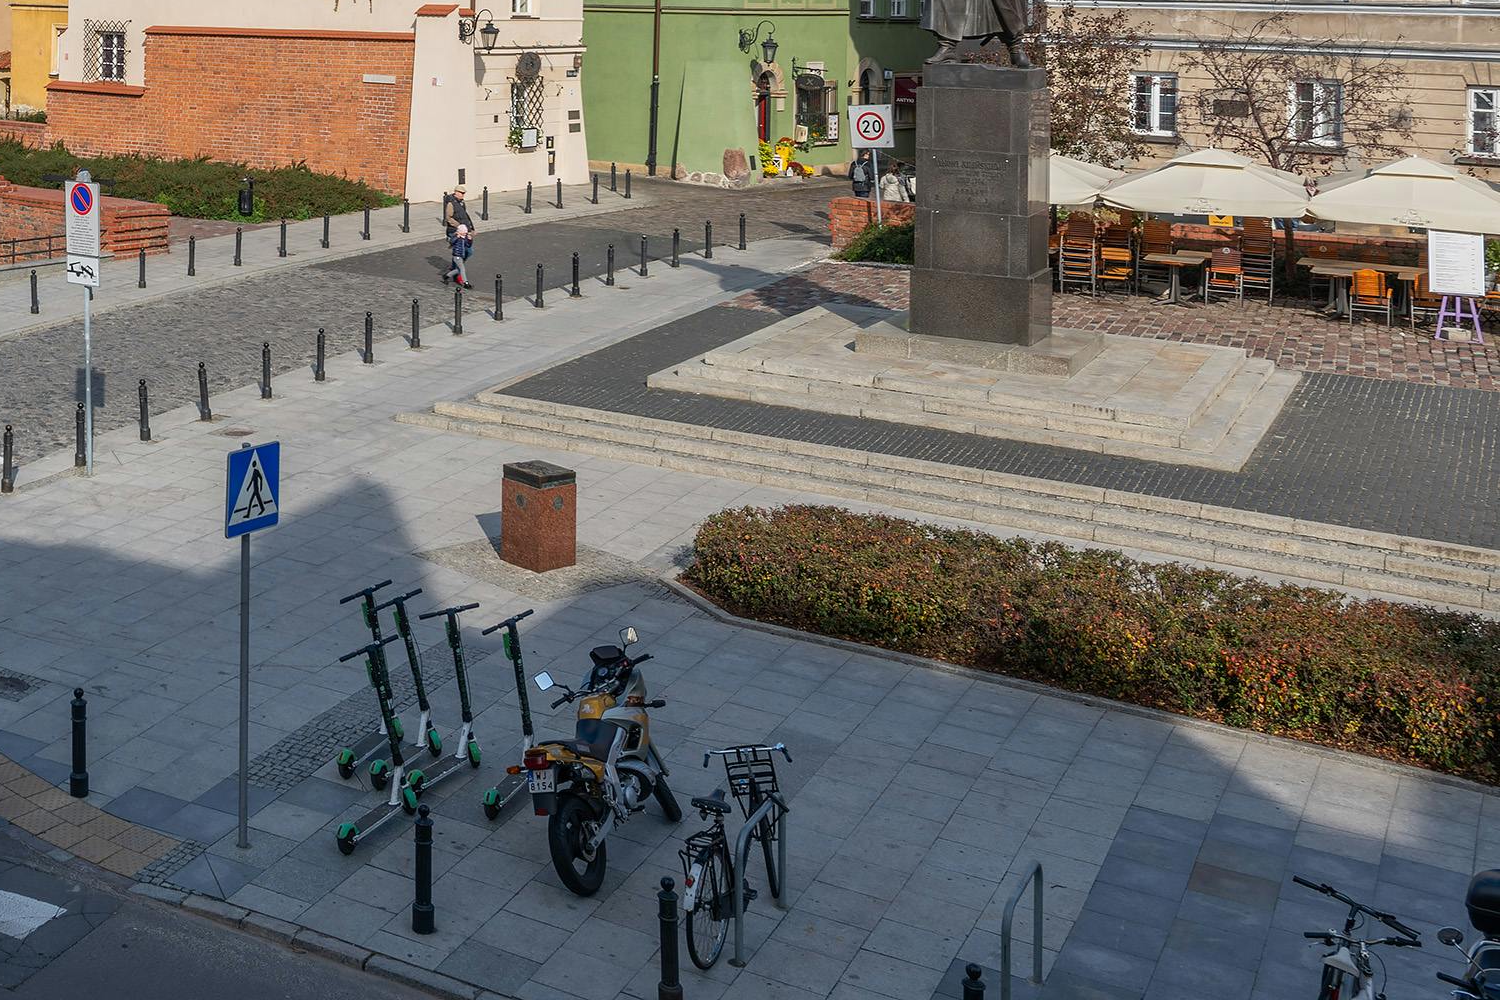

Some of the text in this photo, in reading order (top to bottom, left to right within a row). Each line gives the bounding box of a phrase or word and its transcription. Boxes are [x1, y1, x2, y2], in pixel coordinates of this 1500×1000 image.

[862, 120, 881, 133] 20
[535, 771, 547, 780] WJ
[530, 781, 553, 791] 8154
